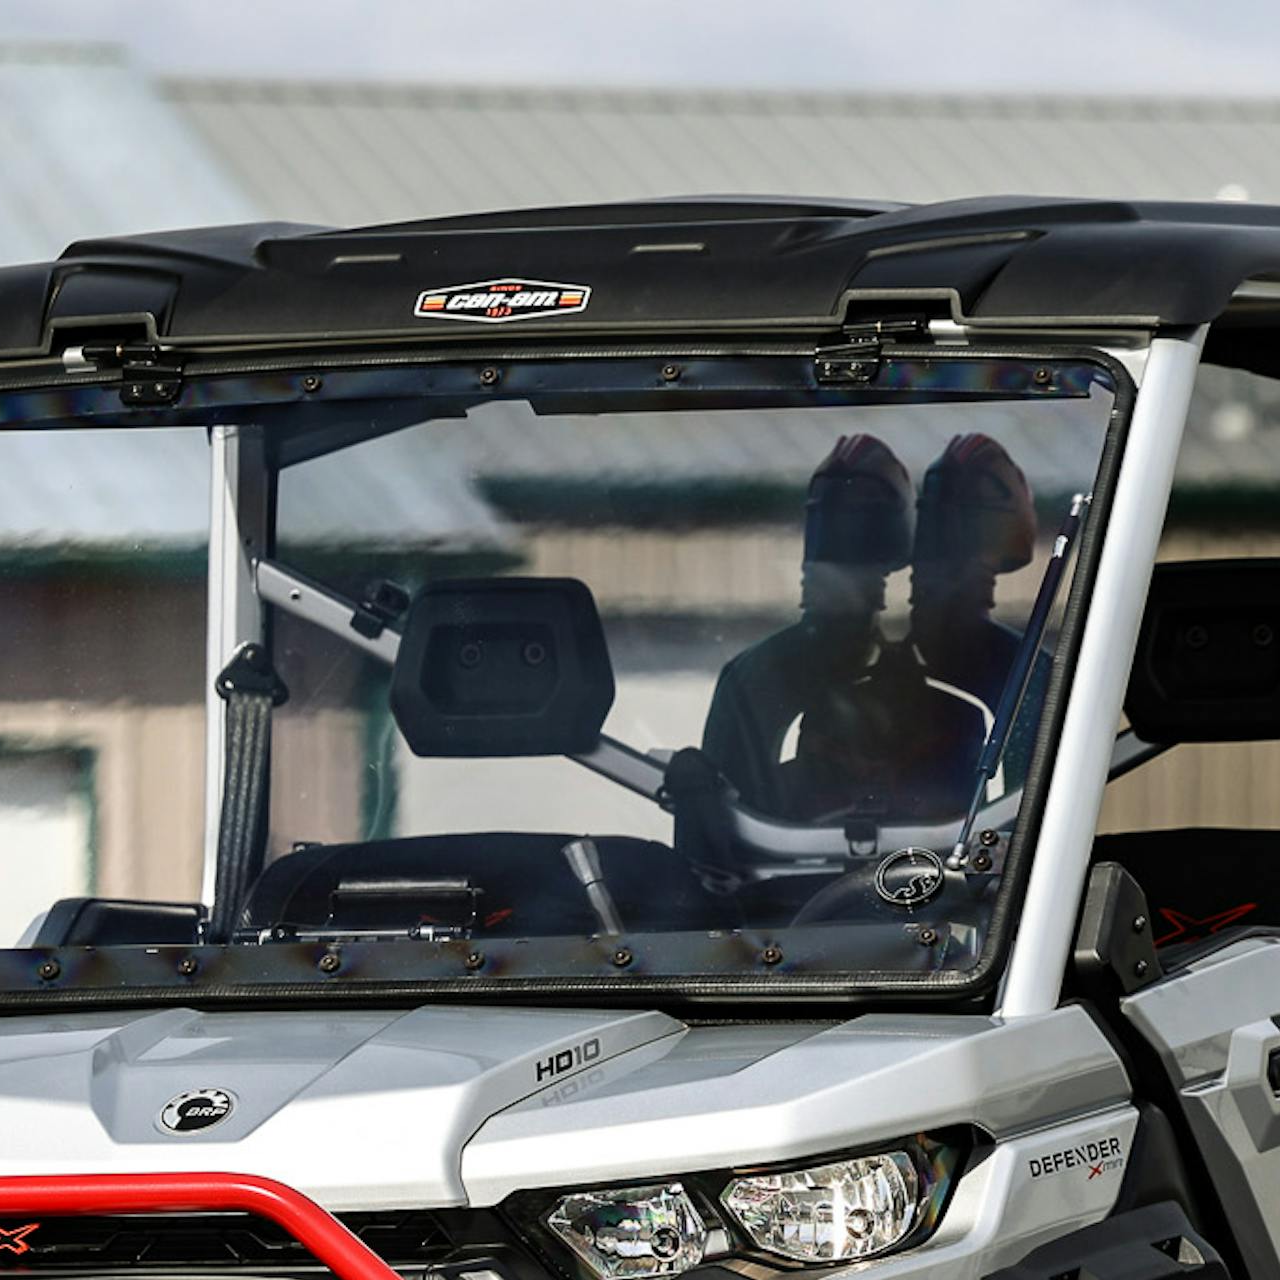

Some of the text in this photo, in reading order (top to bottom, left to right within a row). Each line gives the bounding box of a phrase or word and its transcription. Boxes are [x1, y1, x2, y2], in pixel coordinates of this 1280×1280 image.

[446, 291, 556, 310] can-am
[536, 1038, 600, 1082] HD10
[186, 1106, 227, 1117] BRP
[1029, 1137, 1121, 1177] DEFENDER
